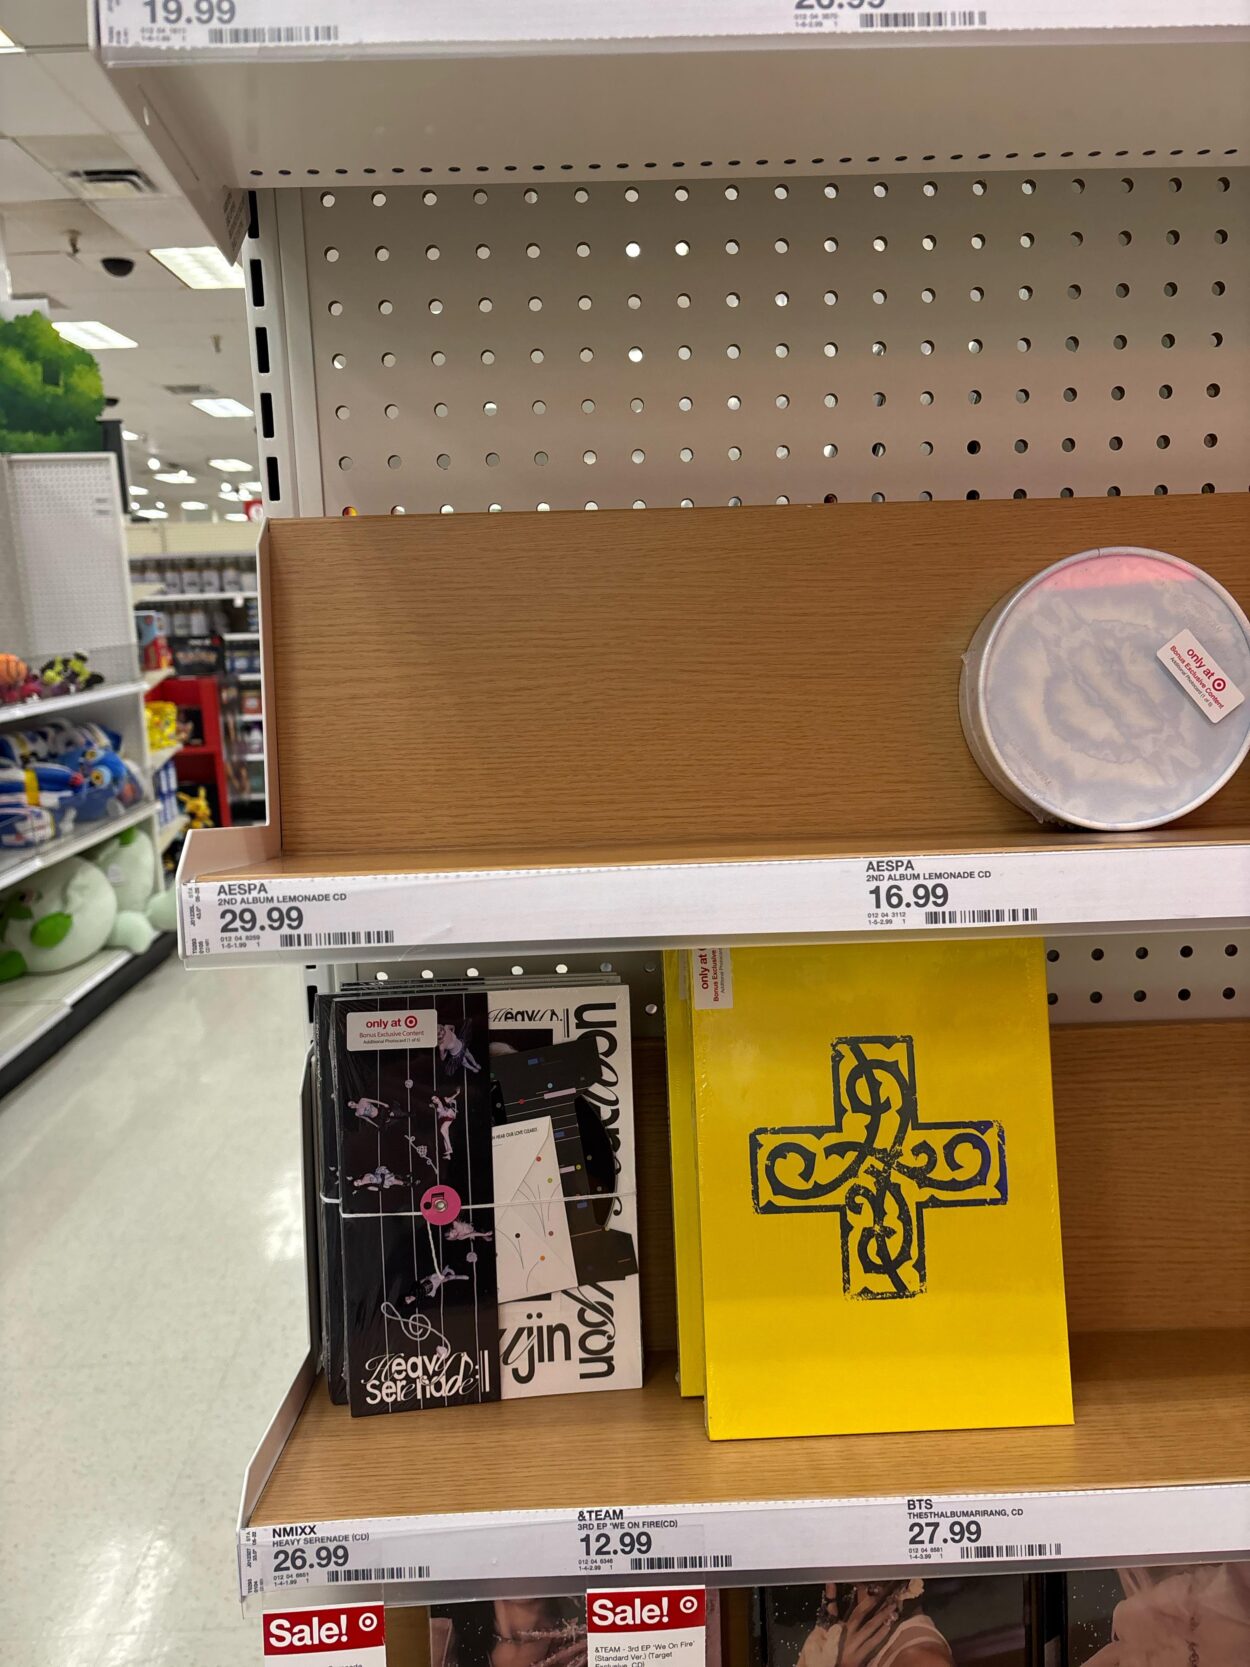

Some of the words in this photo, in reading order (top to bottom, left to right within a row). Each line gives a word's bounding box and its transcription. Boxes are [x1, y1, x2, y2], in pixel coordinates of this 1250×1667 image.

[144, 0, 236, 24] 19.99
[1186, 648, 1206, 668] only
[1202, 668, 1215, 680] at
[1170, 645, 1186, 664] Bonus
[1184, 662, 1206, 688] Exclusive
[1205, 687, 1224, 710] Content
[866, 860, 914, 872] AESPA
[866, 874, 885, 882] 2ND
[887, 873, 920, 881] ALBUM
[923, 871, 976, 880] LEMONADE
[978, 870, 992, 878] CD
[217, 882, 268, 896] AESPA
[868, 882, 949, 910] 16.99
[218, 898, 238, 906] 2ND
[240, 896, 274, 905] ALBUM
[276, 894, 331, 904] LEMONADE
[332, 892, 348, 901] CD
[220, 906, 304, 934] 29.99
[698, 954, 708, 964] at
[698, 967, 710, 990] only
[366, 1018, 388, 1030] only
[390, 1018, 402, 1027] at
[907, 1498, 933, 1510] BTS
[577, 1509, 624, 1522] &TEAM
[1011, 1508, 1024, 1516] CD
[272, 1524, 317, 1538] NMIXX
[578, 1522, 594, 1530] 3RD
[627, 1522, 640, 1530] ON
[642, 1520, 678, 1529] FIRE(CD)
[908, 1520, 982, 1545] 27.99
[272, 1538, 301, 1548] HEAVY
[303, 1534, 350, 1546] SERENADE
[352, 1532, 370, 1542] (CD)
[580, 1531, 652, 1556] 12.99
[273, 1545, 350, 1573] 26.99
[592, 1596, 669, 1626] Sale!
[269, 1614, 348, 1648] Sale!
[594, 1654, 628, 1662] (Standard
[648, 1652, 673, 1660] (Target
